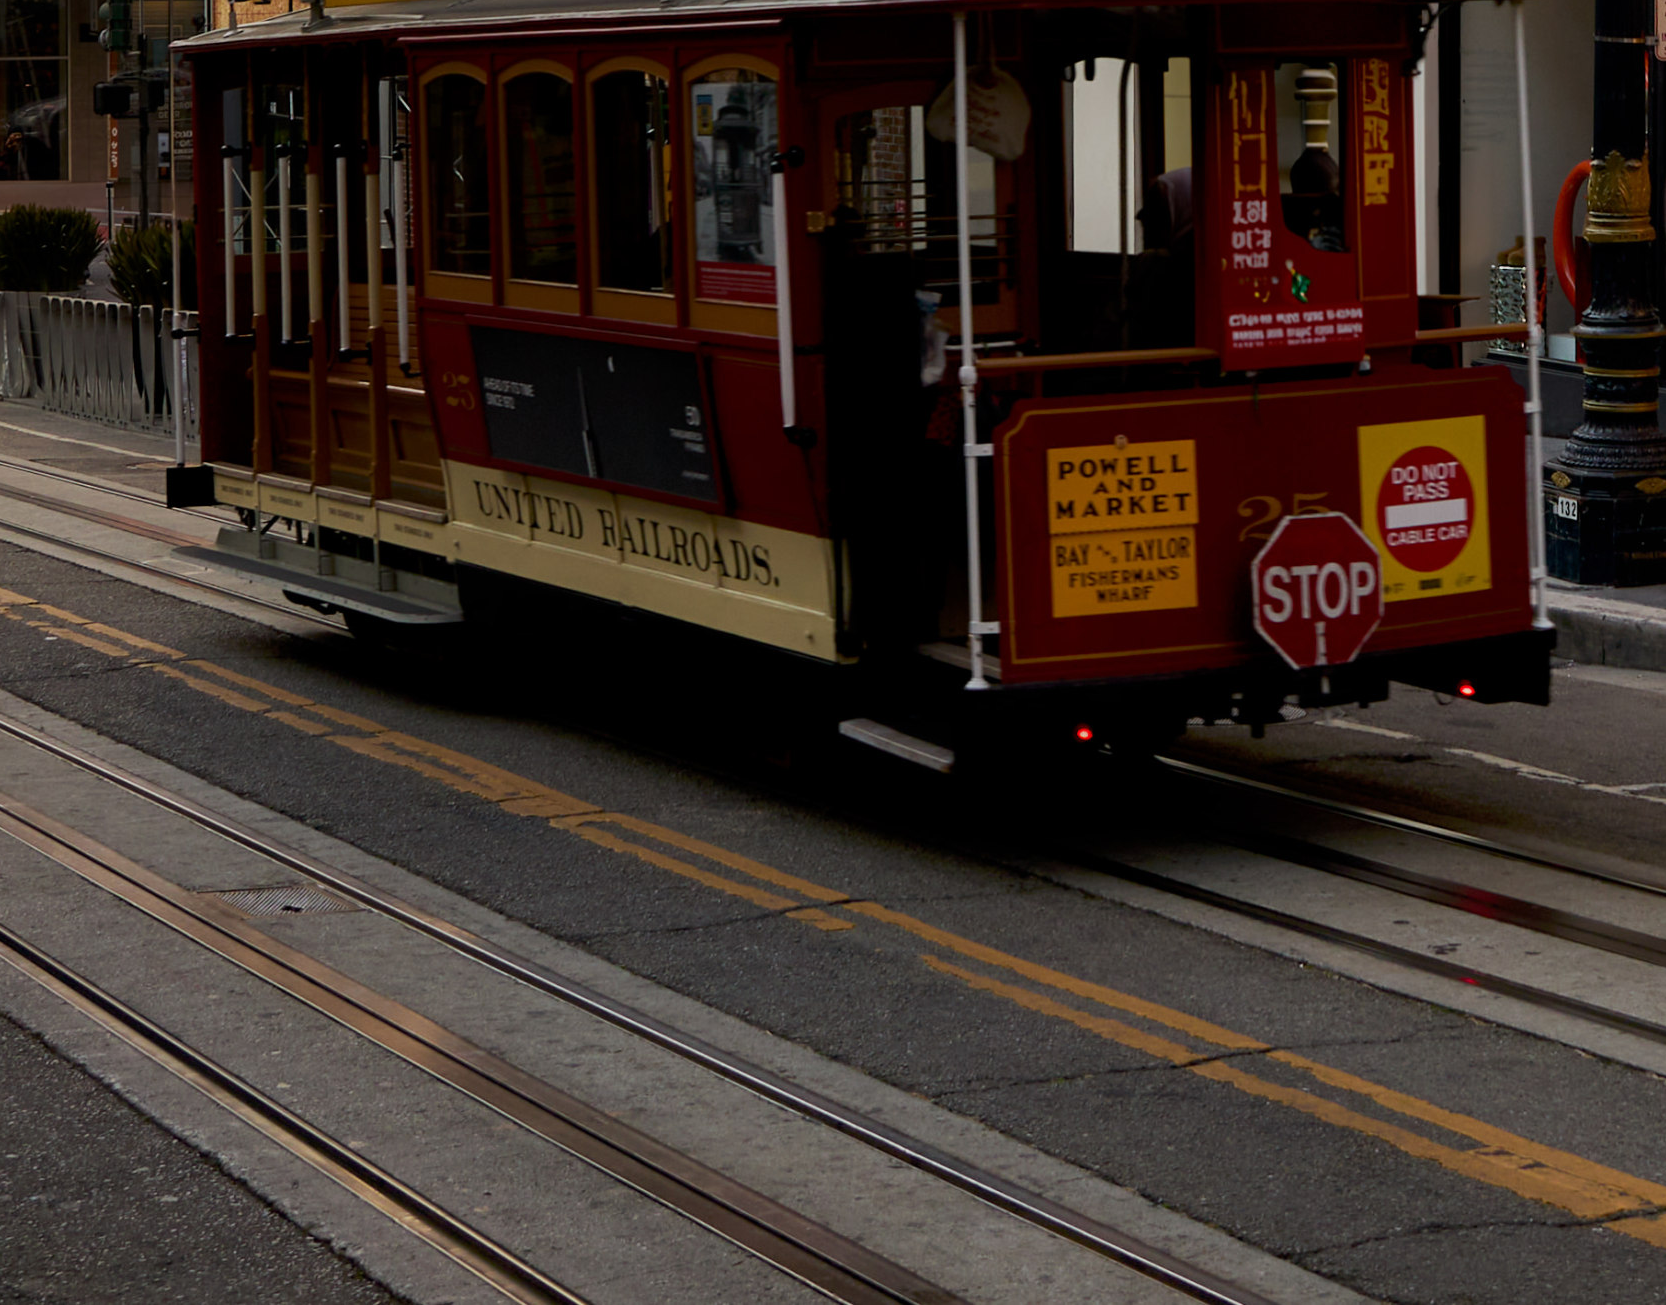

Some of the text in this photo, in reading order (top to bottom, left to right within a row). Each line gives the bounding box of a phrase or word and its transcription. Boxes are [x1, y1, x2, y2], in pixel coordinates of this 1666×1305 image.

[1058, 454, 1188, 480] POWELL
[1391, 461, 1459, 485] DO NOT
[1093, 477, 1156, 494] AND
[1403, 482, 1450, 501] PASS
[1056, 493, 1191, 519] MARKET
[1560, 499, 1577, 518] 132
[474, 480, 780, 587] UNITED RAILROADS.
[1387, 525, 1468, 547] CABLE CAR
[1055, 543, 1090, 567] BAY
[1123, 537, 1191, 562] TAYLOR
[1069, 565, 1180, 588] FISHERMANS
[1096, 585, 1155, 604] WHARF
[1263, 562, 1376, 623] STOP
